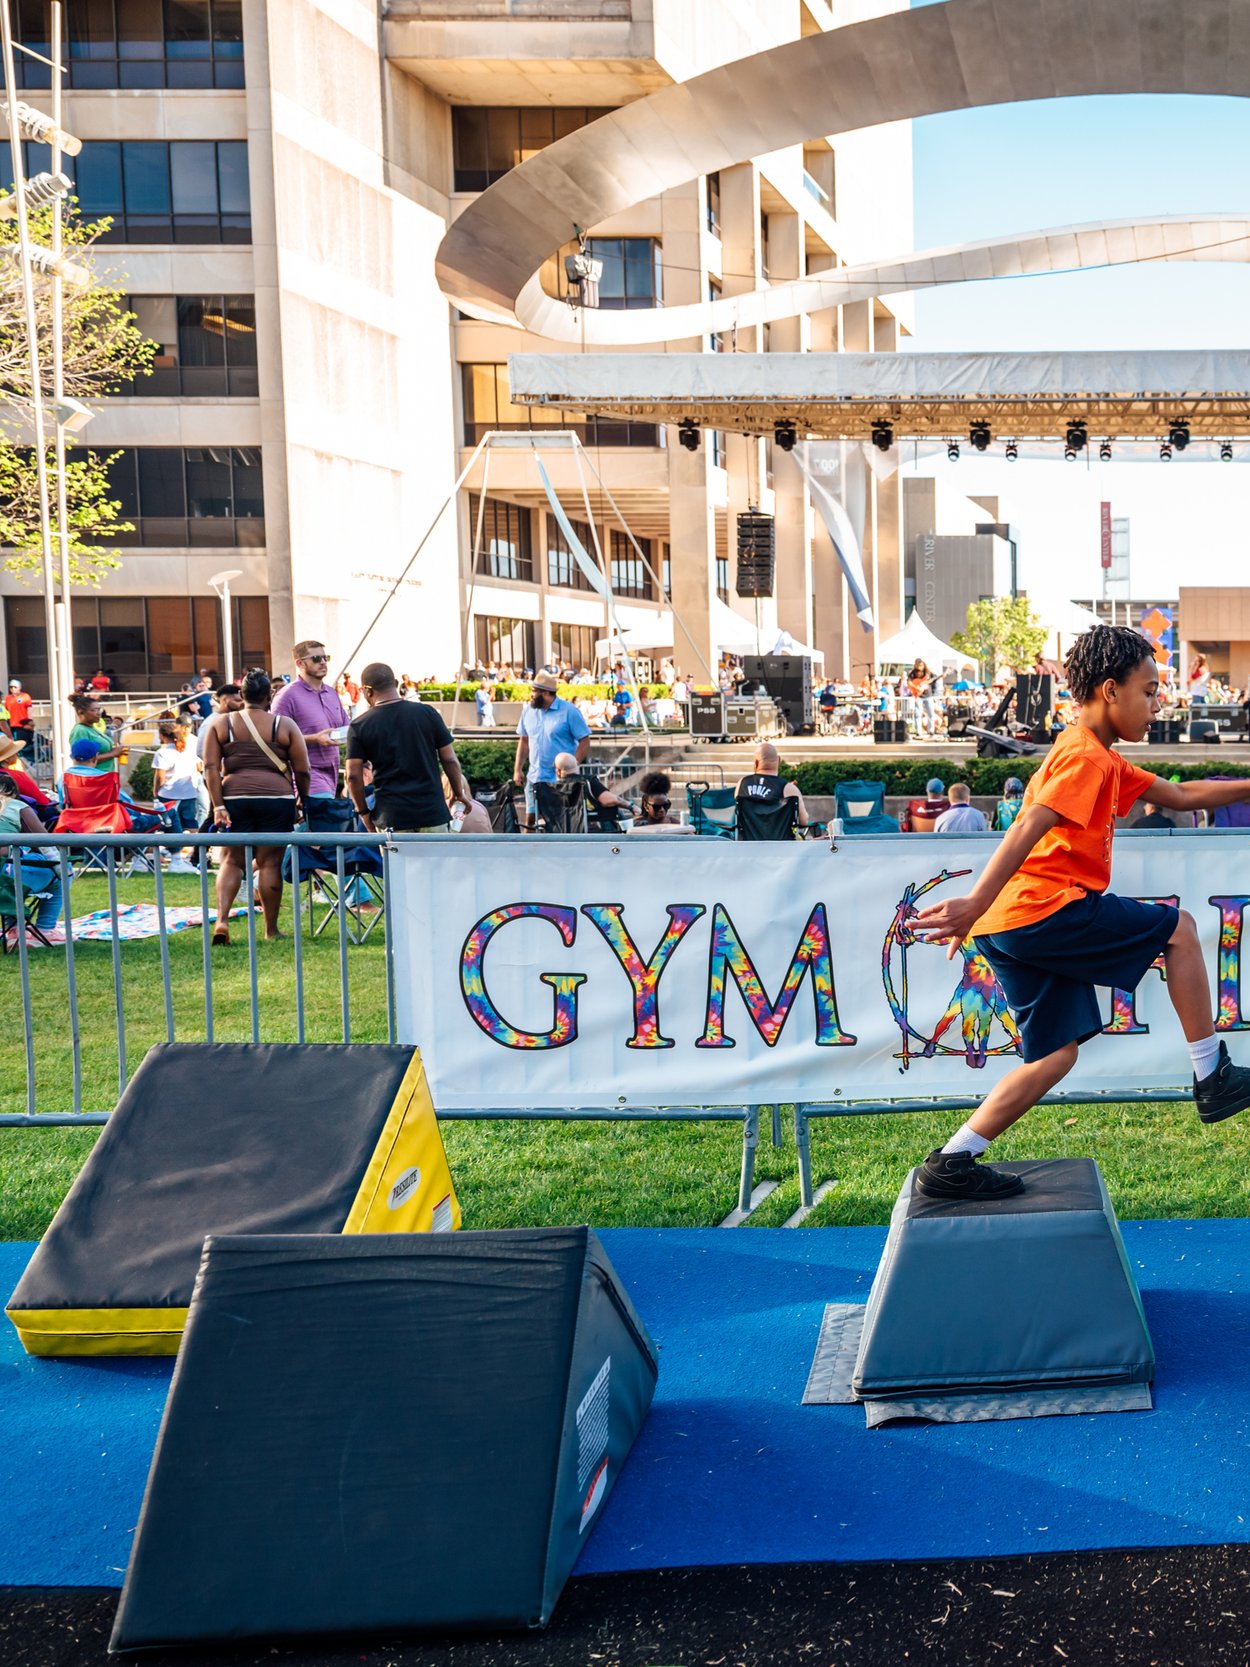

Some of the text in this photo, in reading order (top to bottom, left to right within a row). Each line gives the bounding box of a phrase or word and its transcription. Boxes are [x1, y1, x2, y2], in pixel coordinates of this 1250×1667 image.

[924, 539, 936, 624] RIVER CENTER
[747, 784, 772, 798] POOLE
[459, 902, 857, 1051] GYM
